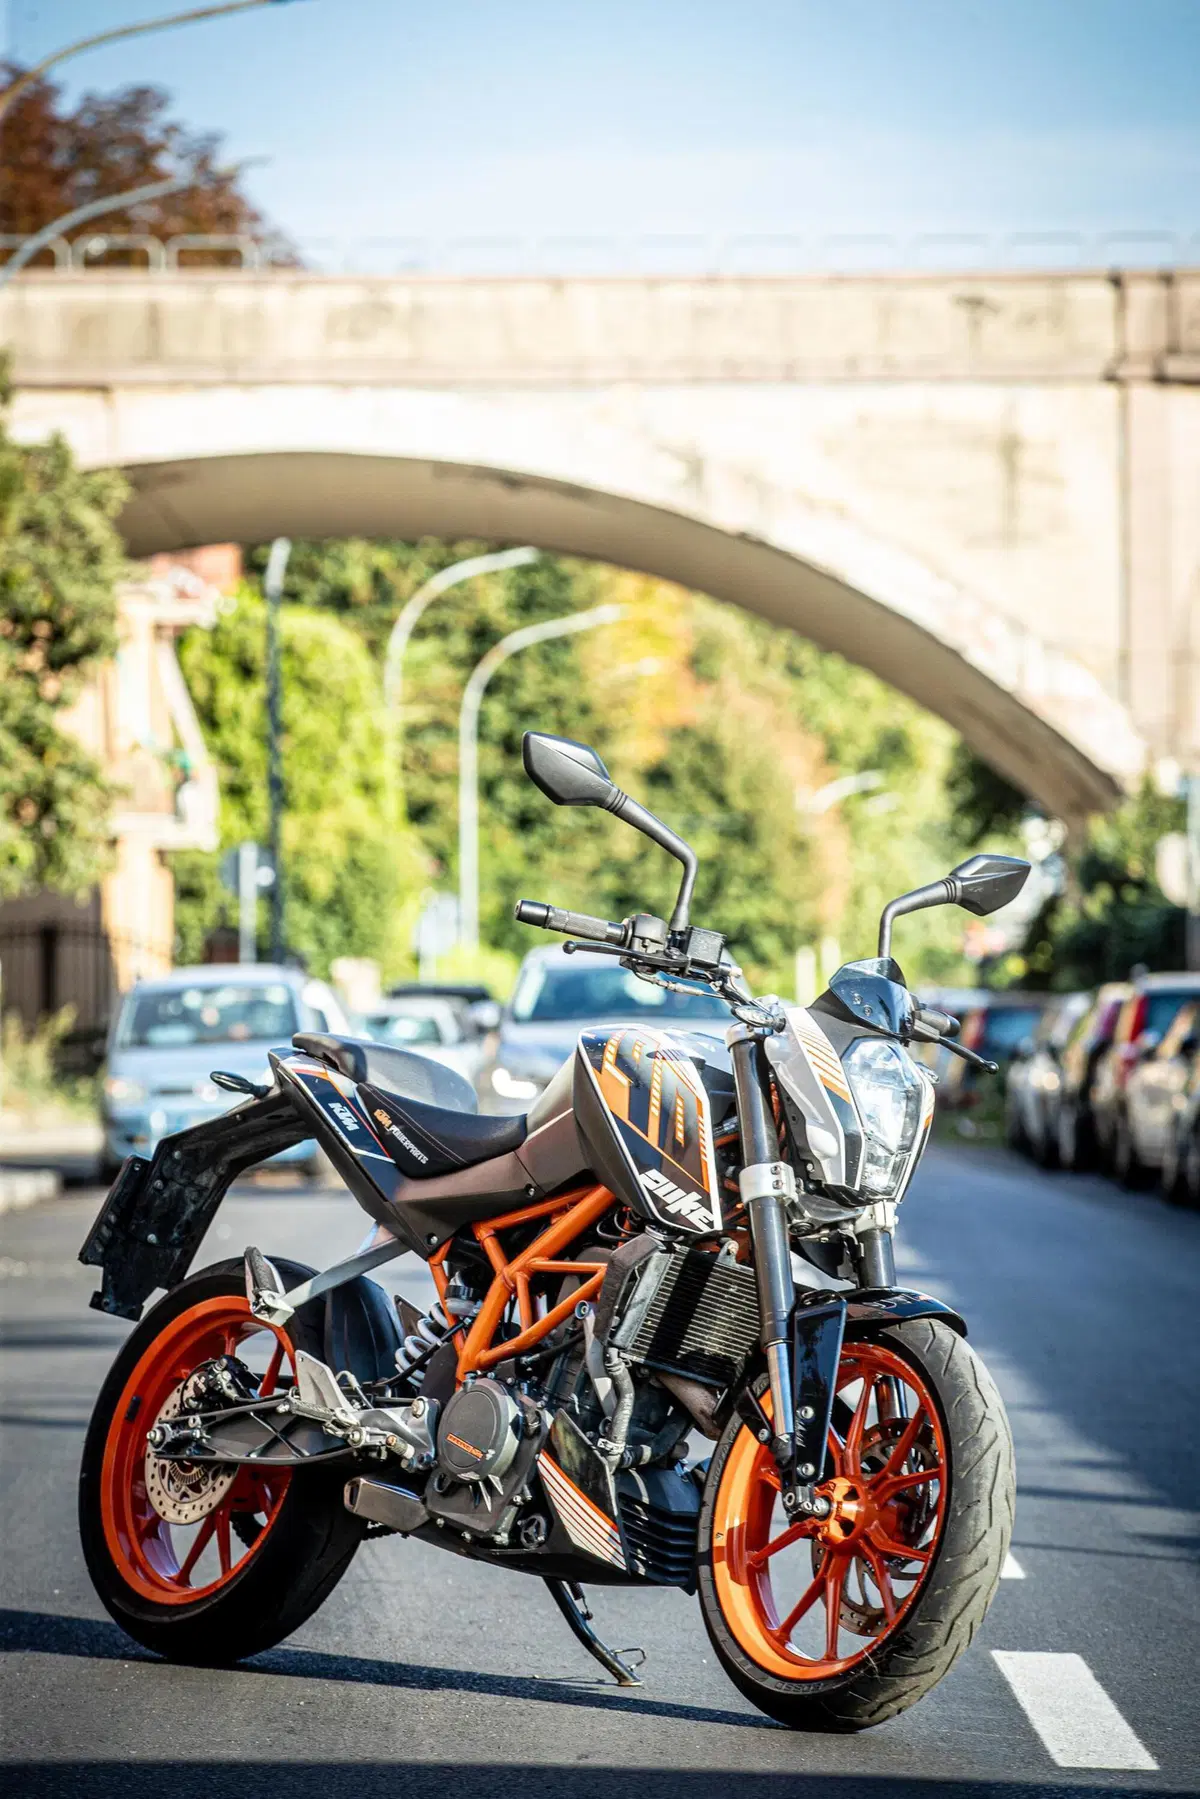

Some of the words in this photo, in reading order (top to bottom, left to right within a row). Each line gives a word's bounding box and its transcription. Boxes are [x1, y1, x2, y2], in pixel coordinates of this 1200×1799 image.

[329, 1102, 359, 1131] KTM
[373, 1109, 392, 1127] KTM
[390, 1125, 428, 1164] POWERPARTS
[639, 1168, 715, 1232] DUKE
